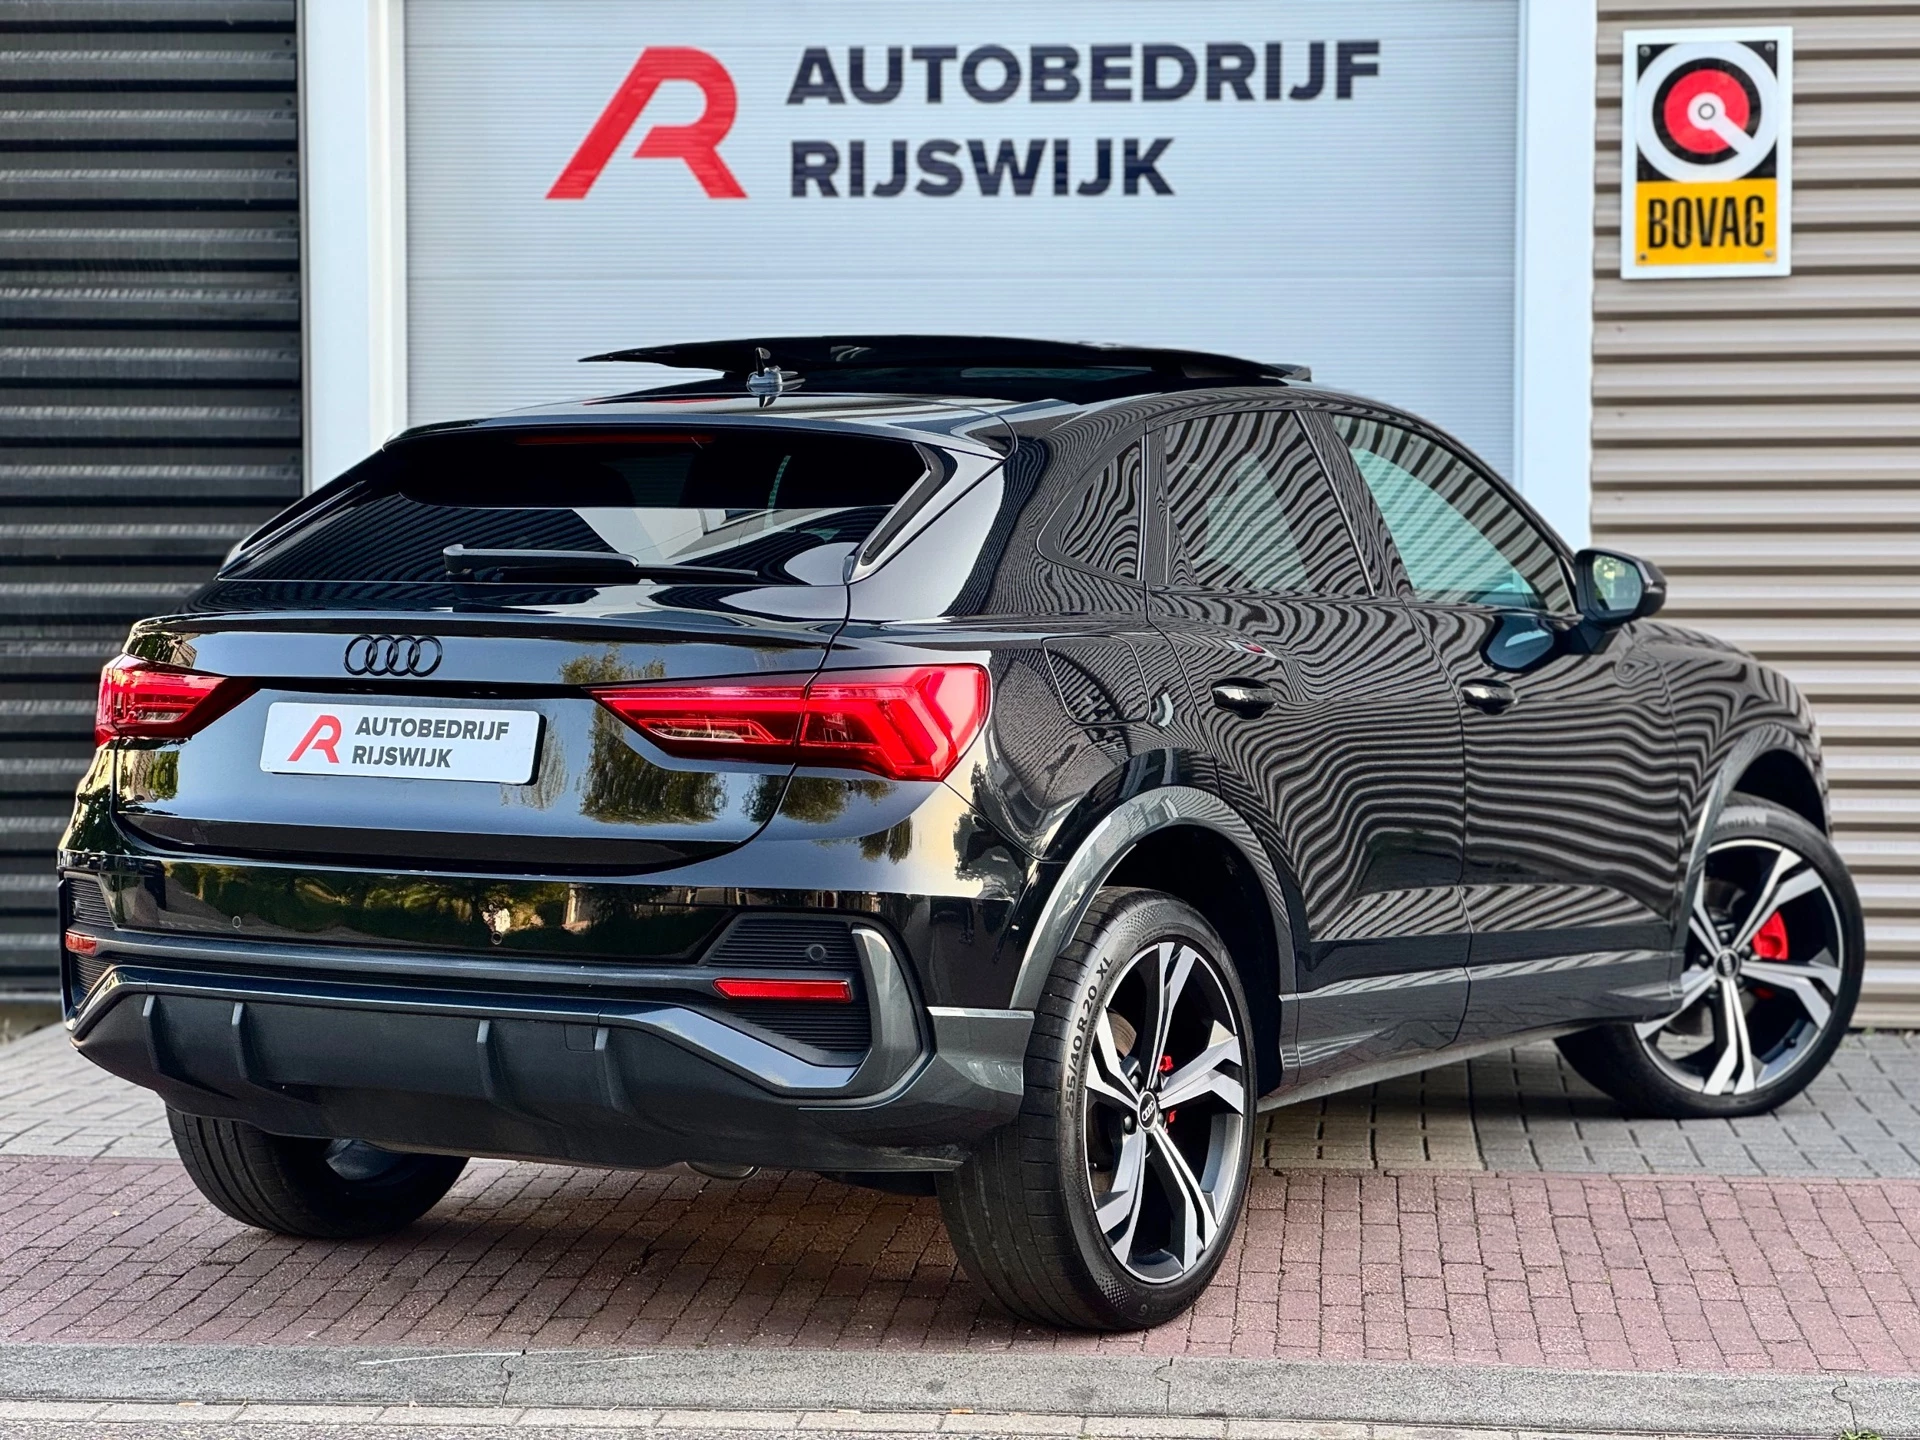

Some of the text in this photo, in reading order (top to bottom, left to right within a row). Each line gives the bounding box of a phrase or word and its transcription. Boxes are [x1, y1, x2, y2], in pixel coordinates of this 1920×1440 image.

[787, 41, 1380, 105] AUTOBEDRIJF
[791, 138, 1174, 198] RIJSWIJK
[1648, 195, 1765, 249] BOVAG
[352, 745, 453, 768] RIJSWIJK
[355, 716, 510, 741] AUTOBEDRIJF
[1065, 1035, 1083, 1119] 255/40
[1077, 1016, 1088, 1033] R
[1083, 985, 1097, 1014] 20
[1096, 956, 1113, 980] XL
